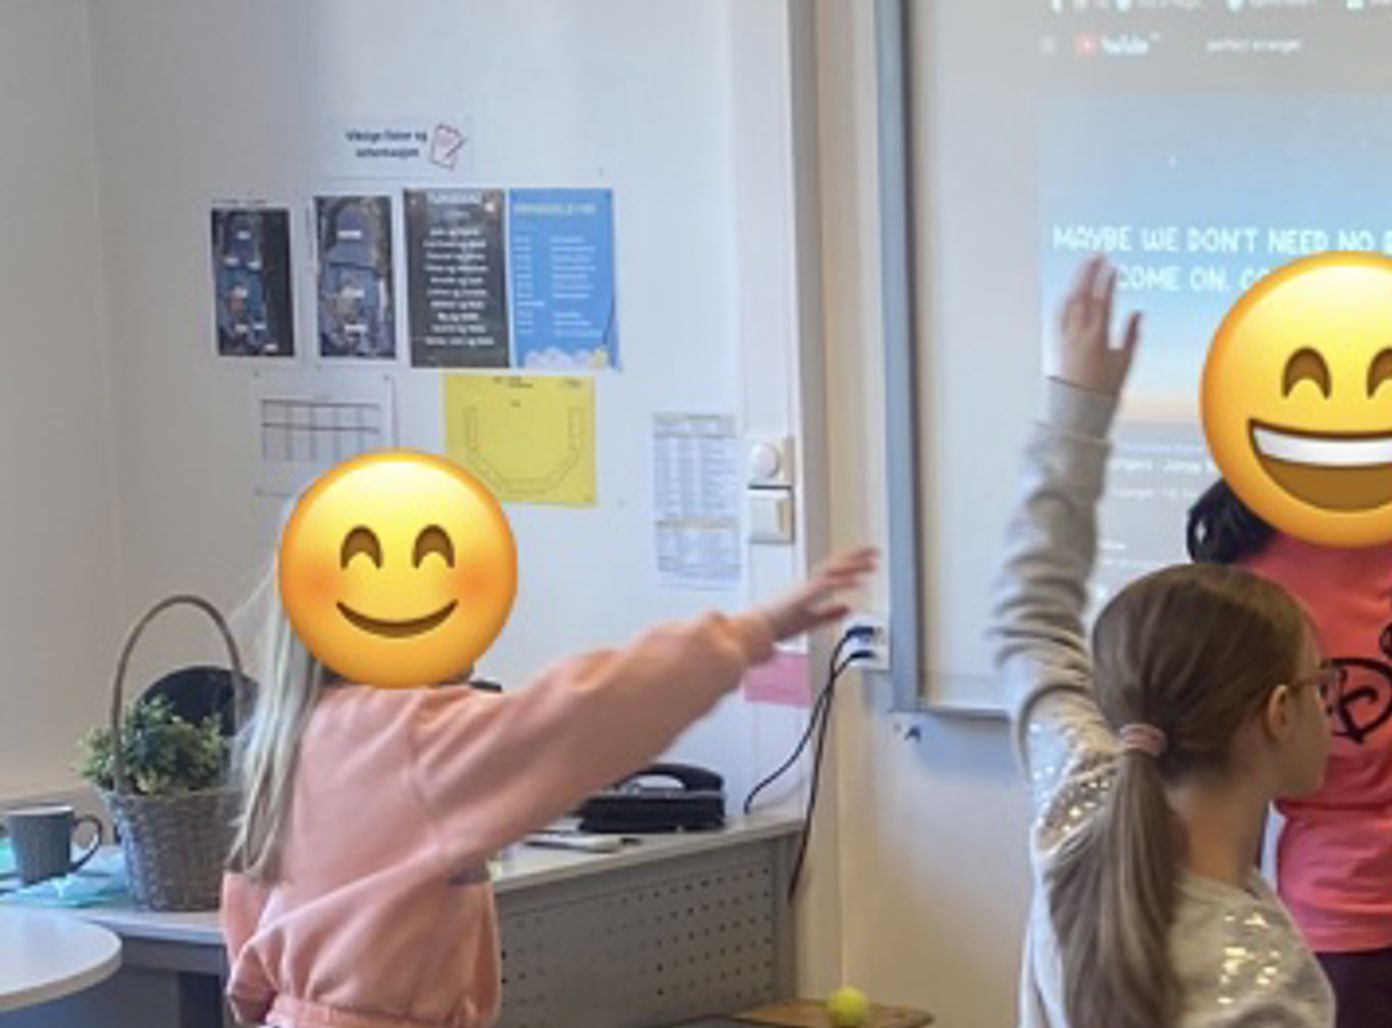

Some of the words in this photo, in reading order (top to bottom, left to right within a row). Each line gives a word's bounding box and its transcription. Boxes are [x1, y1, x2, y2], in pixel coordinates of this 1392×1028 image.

[1052, 225, 1132, 251] MAYBE
[1140, 226, 1180, 251] WE
[1187, 226, 1259, 253] DON'T
[1268, 228, 1328, 255] NEED
[1338, 229, 1375, 252] NO
[1117, 265, 1181, 291] COME
